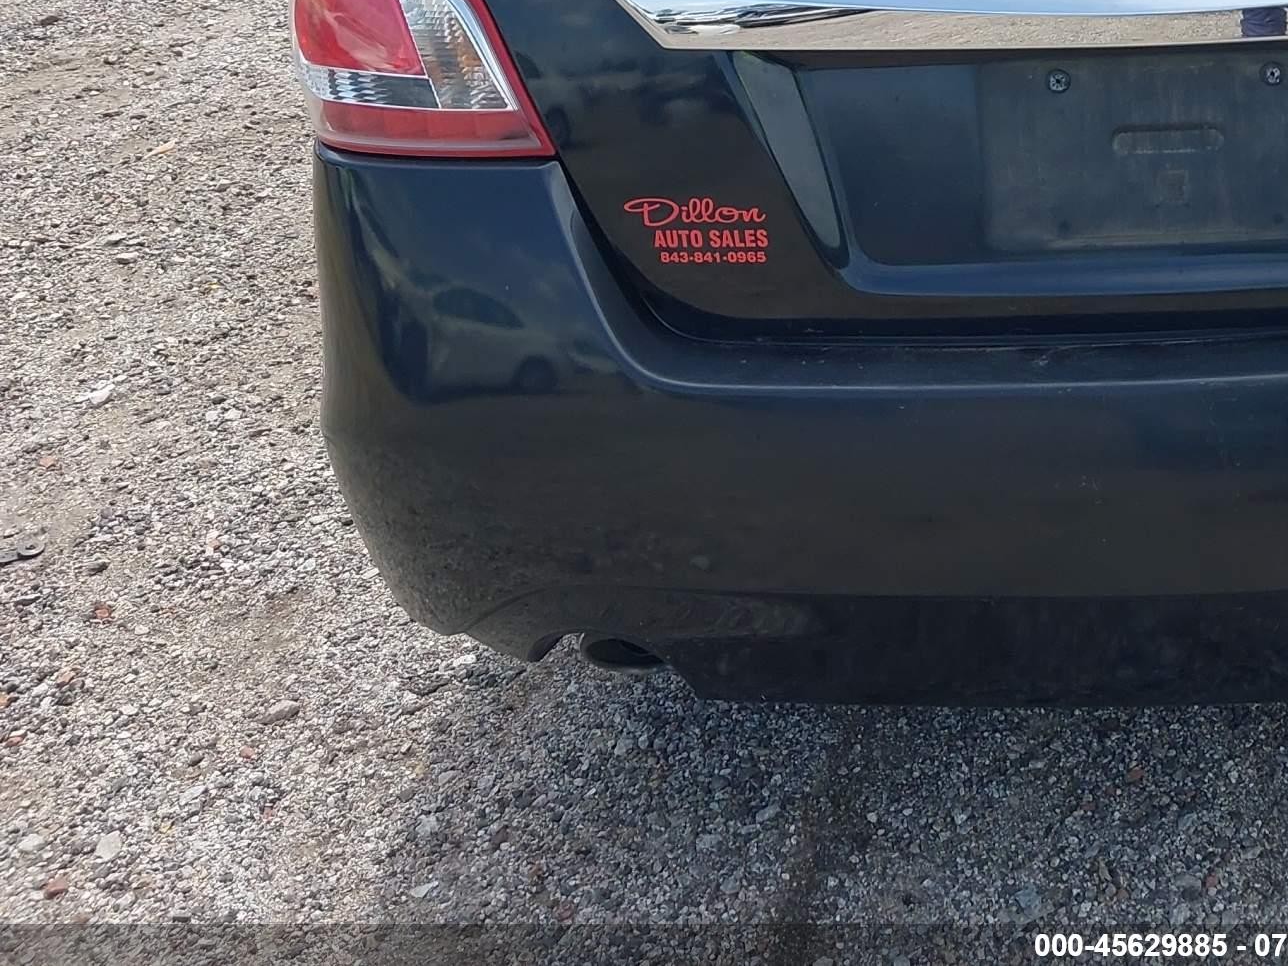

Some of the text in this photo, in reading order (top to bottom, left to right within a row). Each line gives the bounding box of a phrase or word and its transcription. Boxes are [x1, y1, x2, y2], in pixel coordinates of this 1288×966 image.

[623, 198, 766, 227] Dillon
[654, 229, 769, 248] AUTO SALES
[660, 251, 767, 263] 843-841-0965
